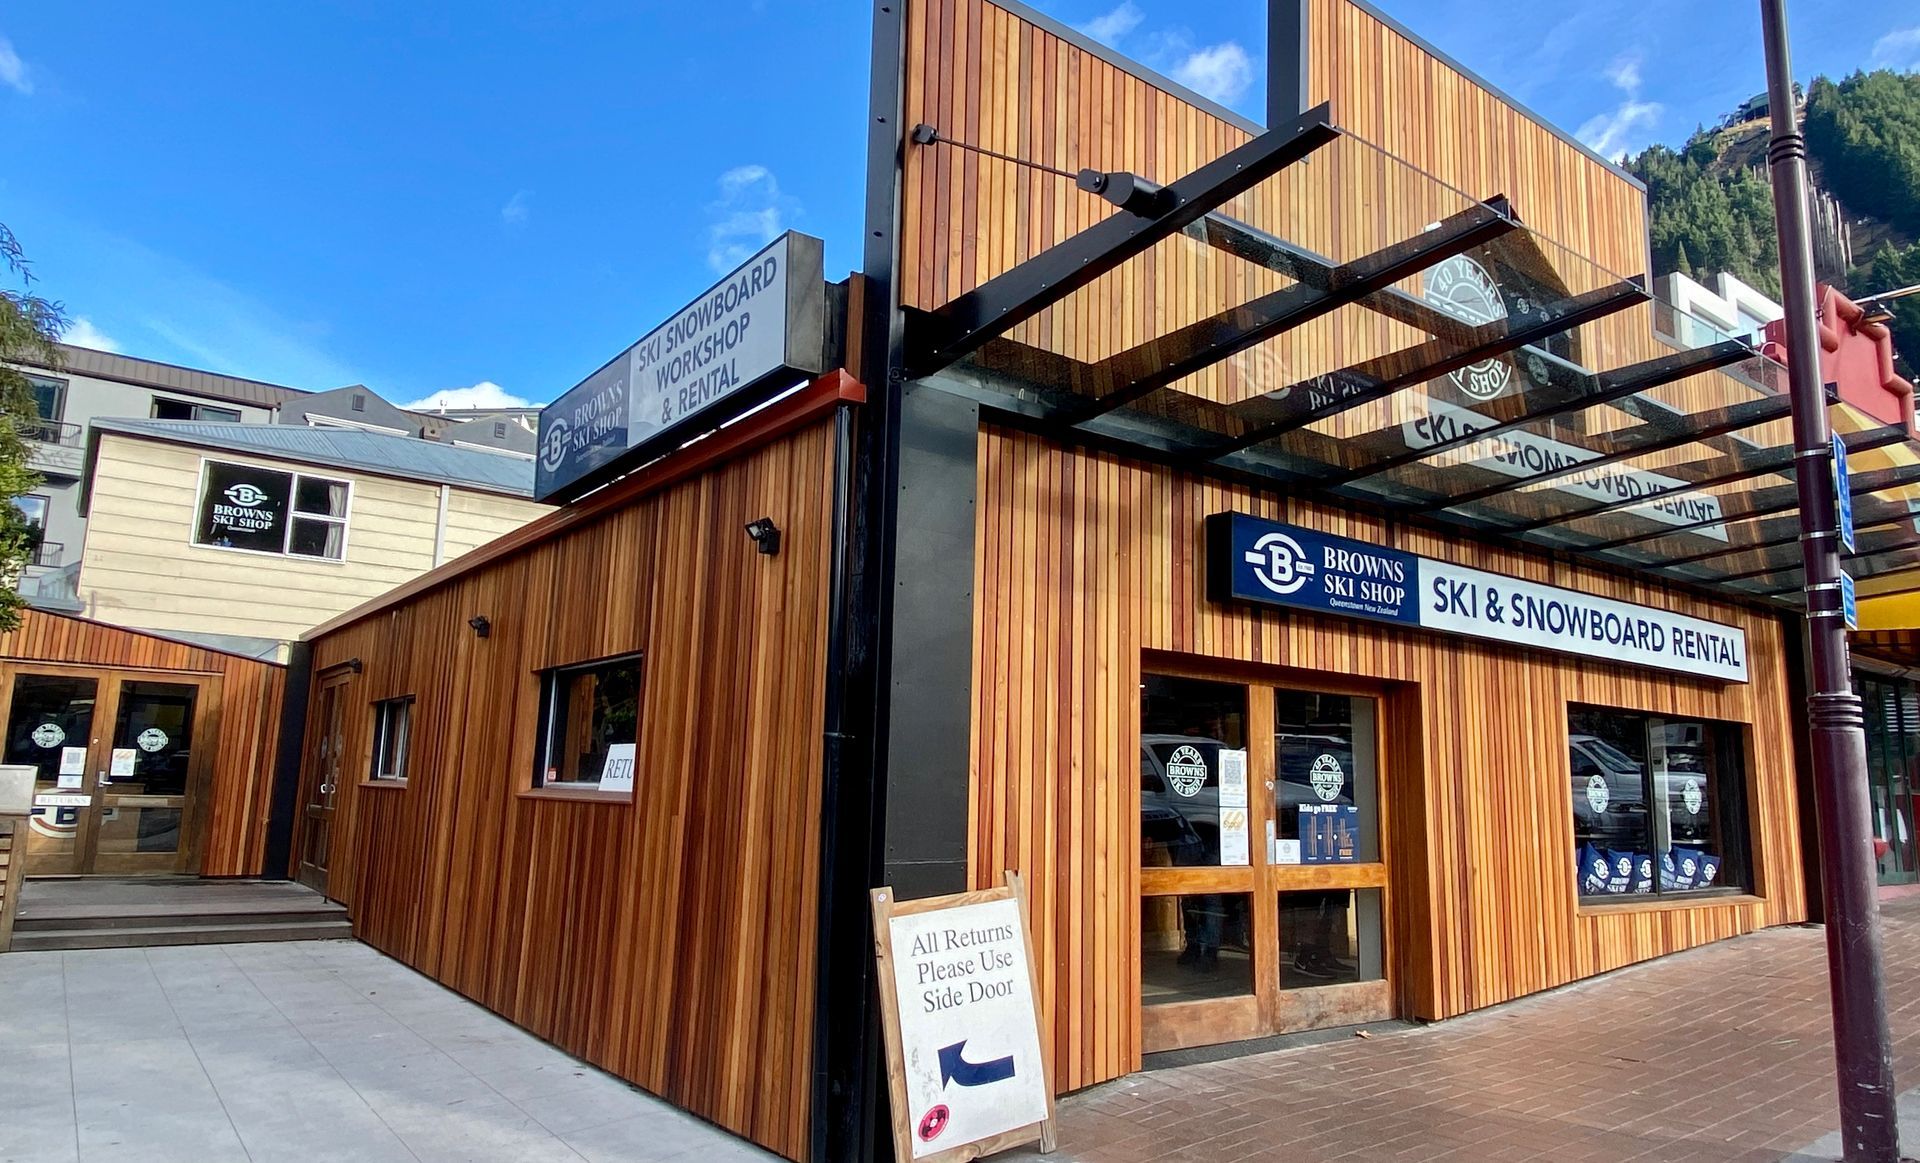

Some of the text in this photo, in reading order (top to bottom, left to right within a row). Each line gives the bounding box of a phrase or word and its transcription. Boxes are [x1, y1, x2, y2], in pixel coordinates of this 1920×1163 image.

[1437, 267, 1453, 292] 40
[1454, 260, 1505, 318] YEARS
[639, 256, 777, 371] SKI SNOWBOARD
[656, 312, 750, 392] WORKSHOP
[661, 357, 740, 424] & RENTAL
[1470, 360, 1506, 394] SHOP
[574, 380, 623, 430] BROWNS
[573, 426, 590, 452] SKI
[593, 406, 622, 440] SHOP
[212, 514, 234, 525] SKI
[239, 517, 273, 530] SHOP
[213, 504, 273, 521] BROWNS
[1324, 546, 1404, 583] BROWNS
[1325, 574, 1405, 606] SKI SHOP
[1433, 576, 1741, 667] SKI & SNOWBOARD RENTAL
[1169, 765, 1205, 777] BROWNS
[1312, 772, 1342, 783] BROWNS
[39, 794, 87, 805] RETURNS
[911, 924, 1014, 957] All Returns
[916, 949, 1014, 985] Please Use
[923, 979, 1014, 1013] Side Door
